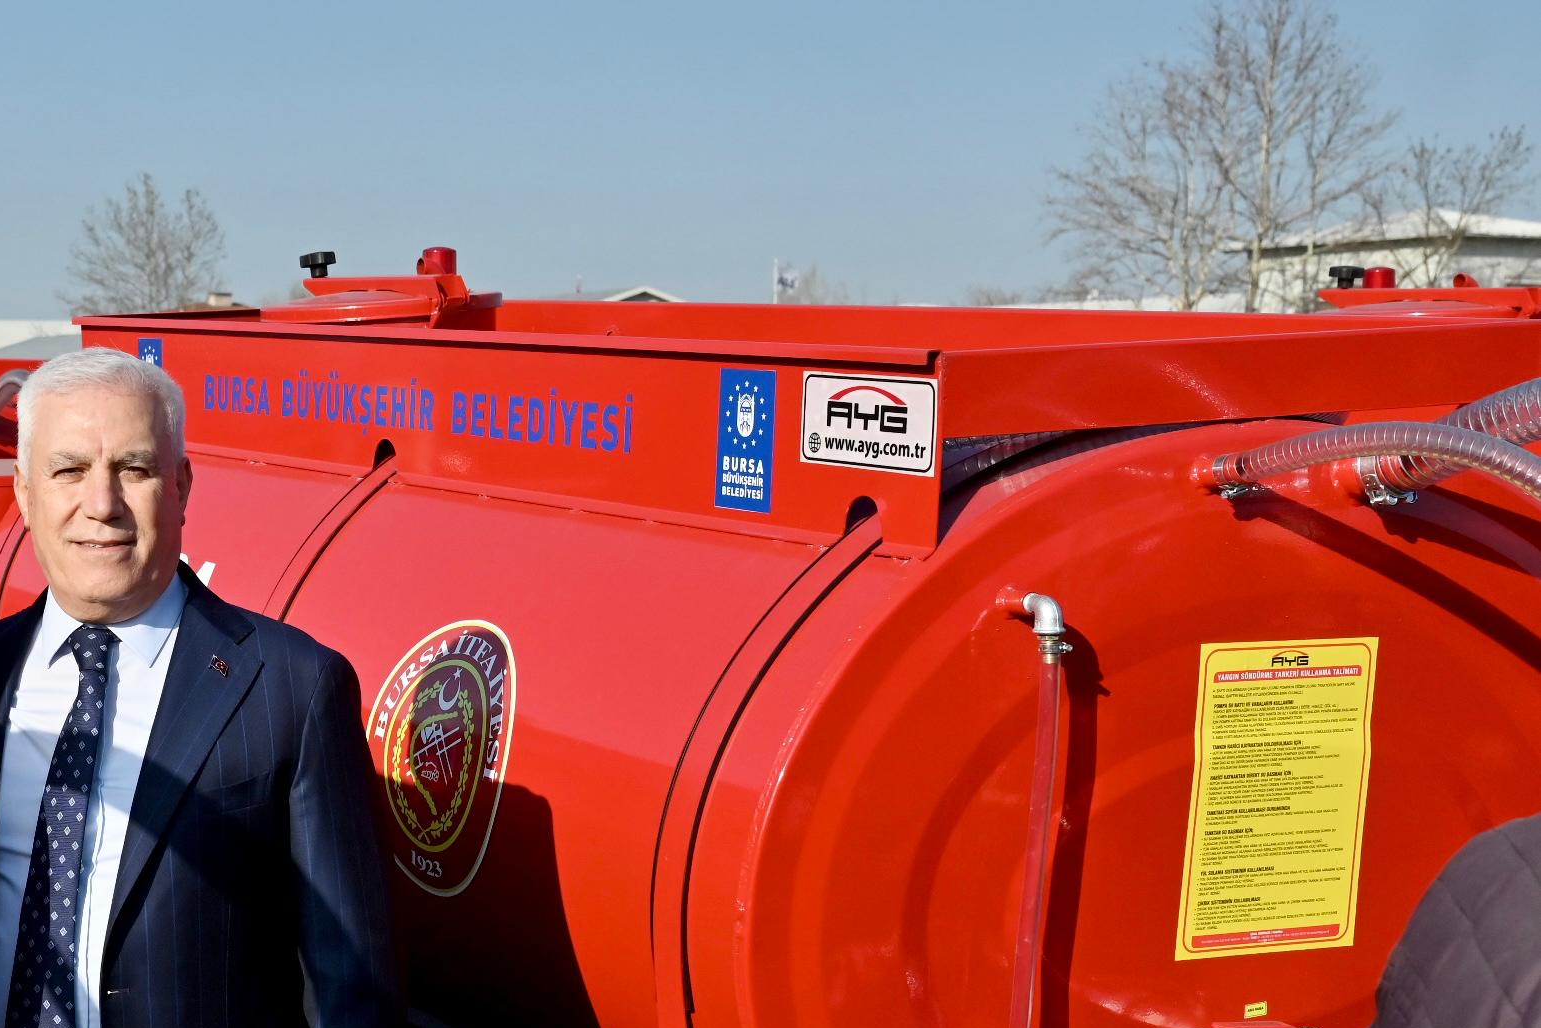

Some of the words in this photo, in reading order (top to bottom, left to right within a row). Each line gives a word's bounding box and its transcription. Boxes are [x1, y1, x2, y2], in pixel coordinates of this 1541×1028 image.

[204, 374, 270, 416] BURSA
[282, 368, 435, 437] BÜYÜKŞEHİR
[451, 388, 633, 454] BELEDİYESİ
[826, 400, 908, 434] AYG
[824, 437, 926, 459] www.ayg.com.tr
[722, 456, 764, 475] BURSA
[722, 472, 764, 489] BÜYÜKŞEHİR
[721, 484, 763, 500] BELEDİYESİ
[1218, 672, 1240, 681] YANGIN
[374, 639, 450, 743] BURSA
[453, 630, 507, 783] İTFAİYESİ
[411, 850, 443, 878] 1923
